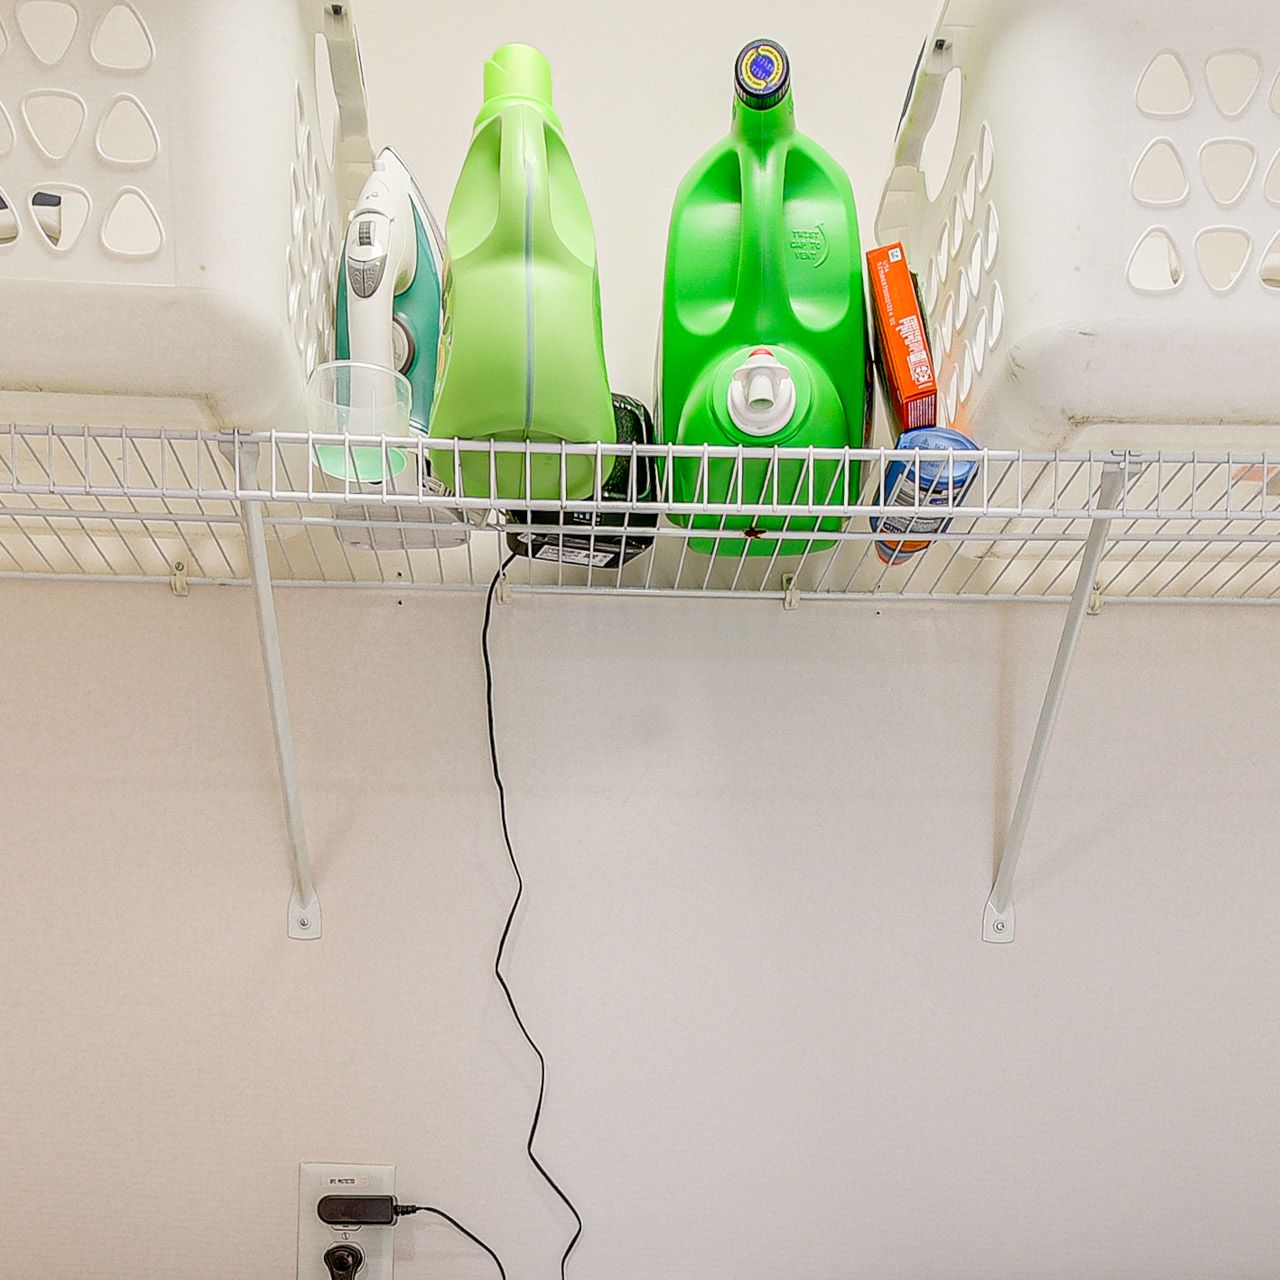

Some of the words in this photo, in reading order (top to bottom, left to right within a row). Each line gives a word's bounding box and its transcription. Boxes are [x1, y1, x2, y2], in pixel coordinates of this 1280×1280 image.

[790, 241, 807, 249] CAP
[810, 241, 821, 250] TO
[795, 251, 817, 261] VENT
